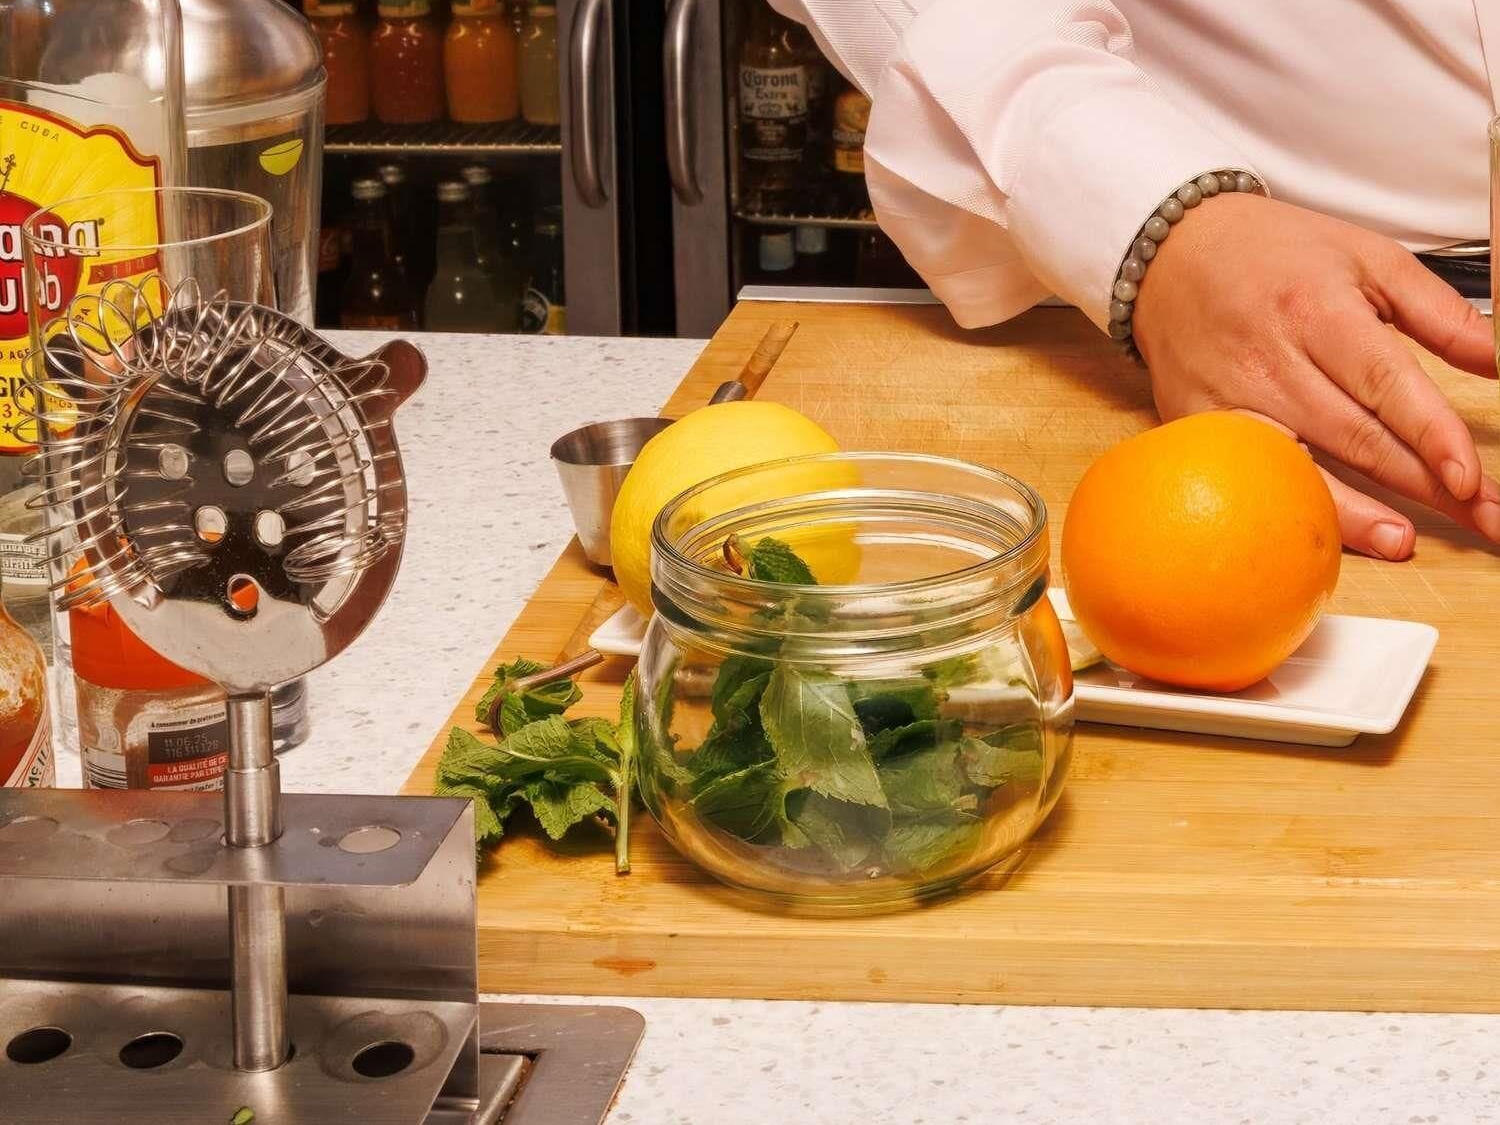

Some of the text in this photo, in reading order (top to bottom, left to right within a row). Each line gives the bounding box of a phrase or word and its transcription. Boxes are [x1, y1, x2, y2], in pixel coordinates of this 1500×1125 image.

[743, 70, 799, 87] Corona
[755, 88, 787, 100] Extra
[20, 120, 61, 142] CUBA
[2, 403, 12, 418] 3
